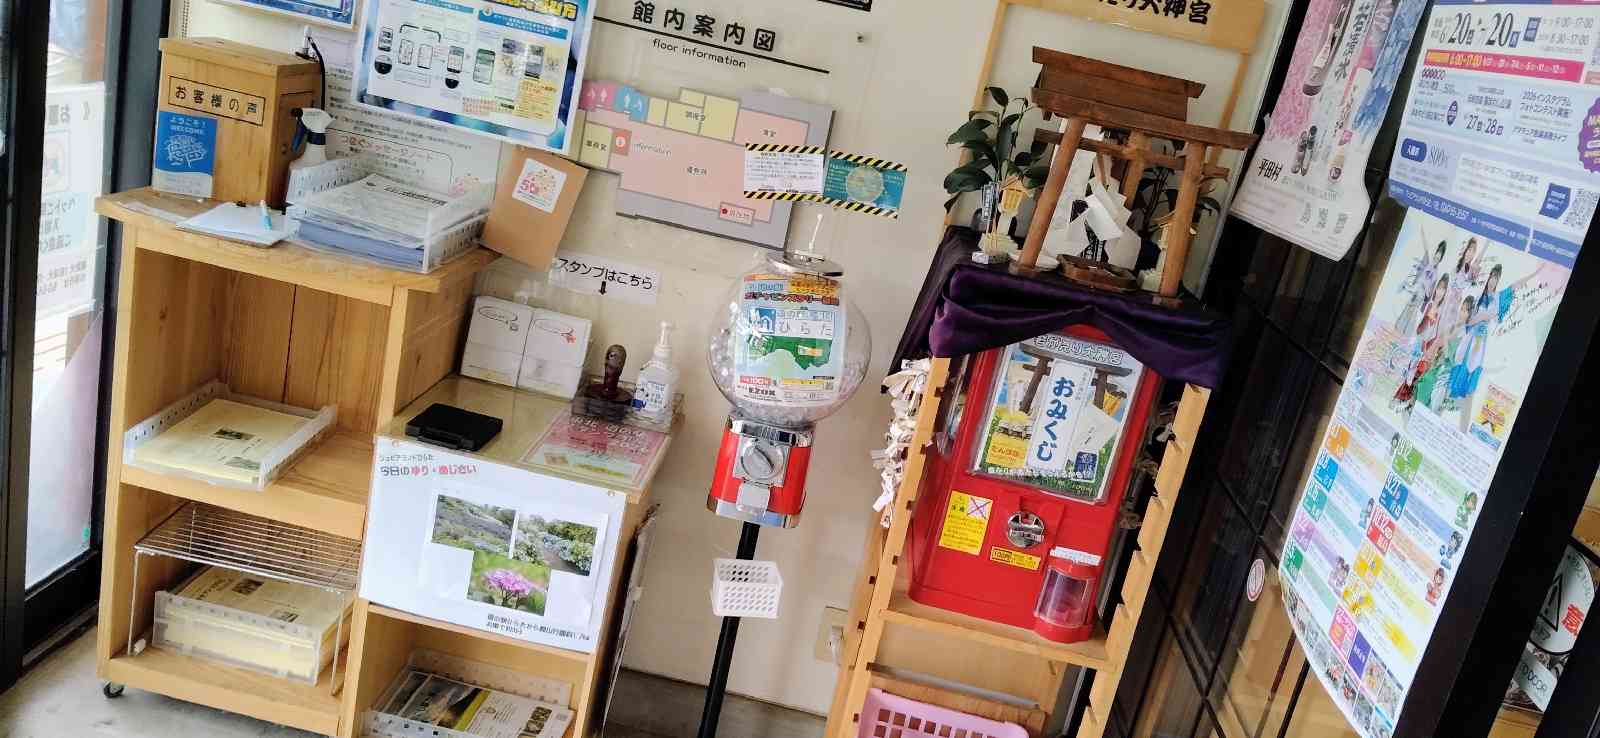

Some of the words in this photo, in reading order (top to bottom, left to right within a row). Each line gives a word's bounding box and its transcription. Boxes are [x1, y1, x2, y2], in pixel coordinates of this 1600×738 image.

[632, 0, 776, 52] 館内案内図
[652, 37, 679, 54] floor
[682, 43, 747, 70] information
[175, 84, 258, 116] お客様の声
[557, 257, 654, 290] スタンプはこちら
[1037, 377, 1074, 462] おみくじ
